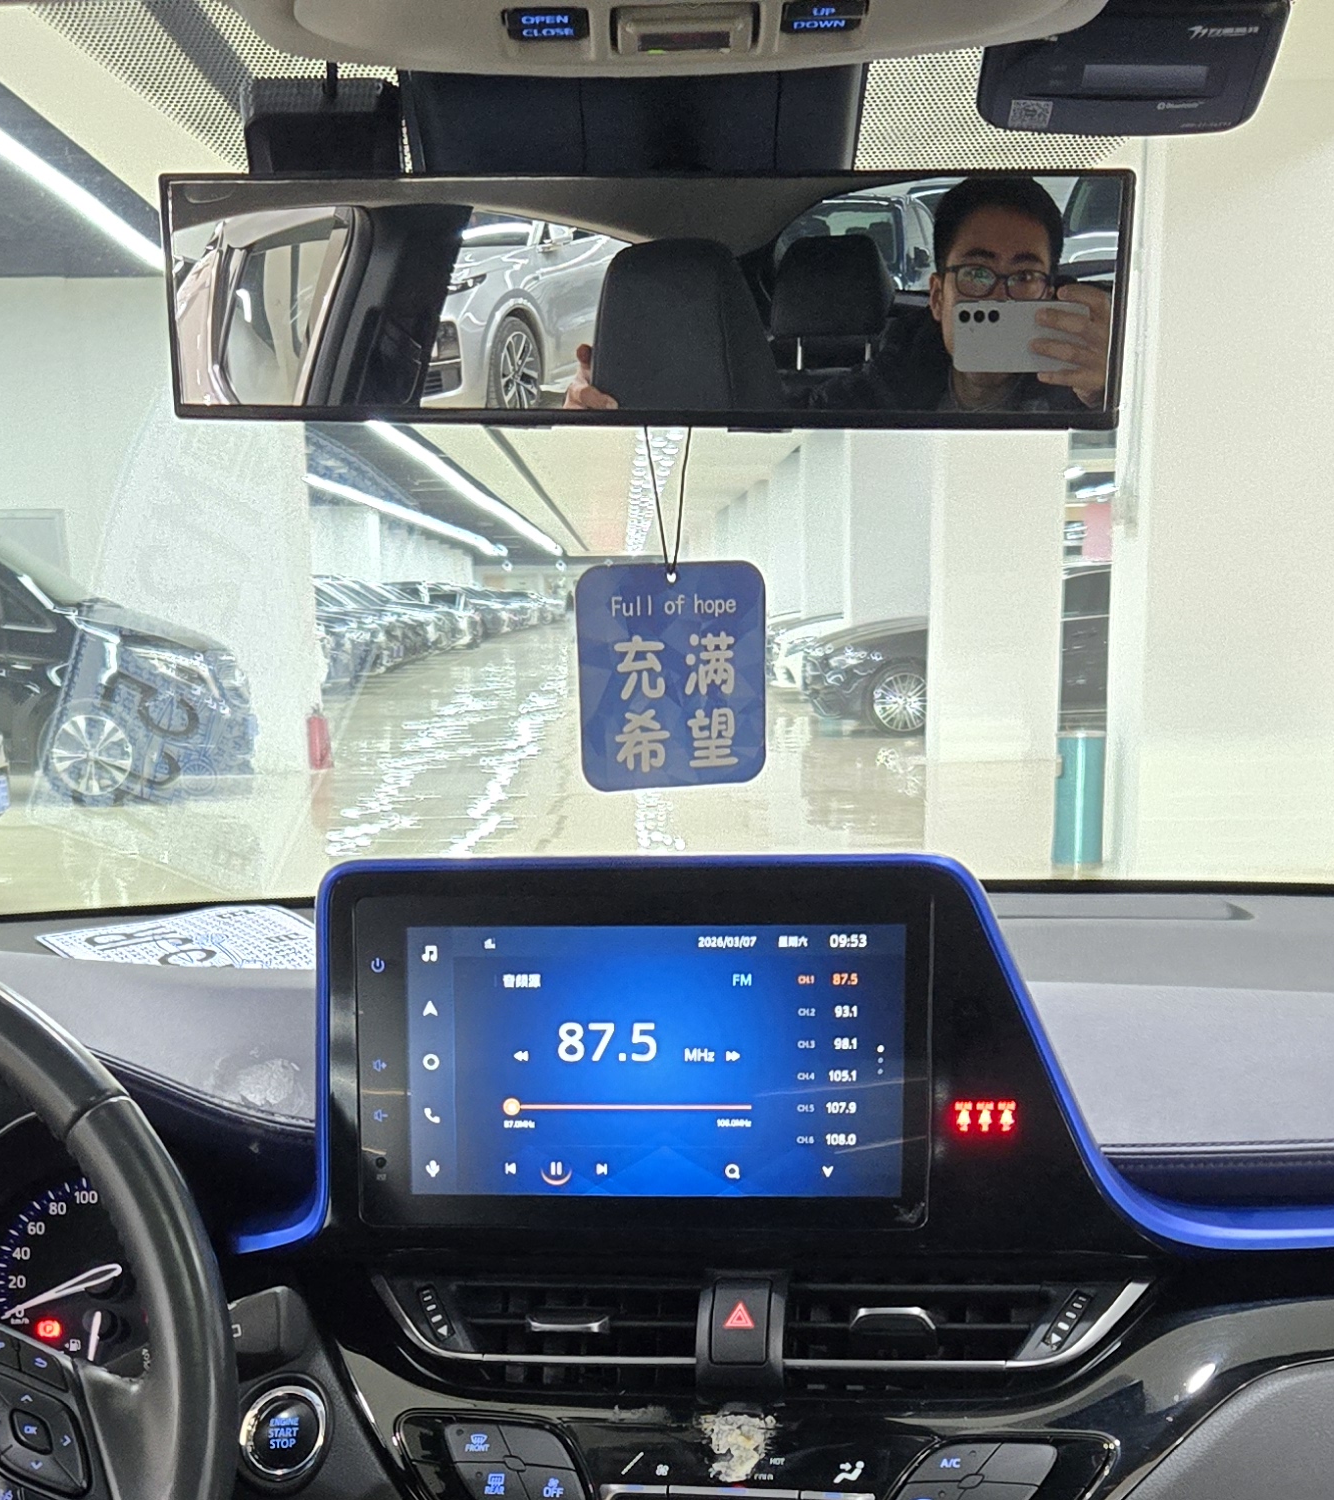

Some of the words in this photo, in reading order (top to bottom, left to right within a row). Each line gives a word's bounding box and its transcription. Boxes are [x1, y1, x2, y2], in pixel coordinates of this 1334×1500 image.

[812, 7, 836, 16] UP
[521, 15, 569, 24] OPEN
[793, 20, 846, 29] DOWN
[522, 28, 574, 37] CLOSE
[611, 595, 652, 617] Full
[664, 595, 685, 615] of
[694, 594, 737, 617] hope
[613, 631, 735, 700] 充满
[614, 708, 739, 773] 希望
[698, 936, 757, 948] 2026/03/07
[829, 934, 867, 948] 09:53
[732, 973, 752, 986] FM
[832, 973, 858, 986] 87.5
[834, 1005, 858, 1018] 93.1
[557, 1022, 658, 1063] 87.5
[684, 1048, 715, 1063] MHz
[833, 1037, 858, 1050] 98.1
[828, 1069, 857, 1082] 105.1
[825, 1101, 857, 1114] 107.9
[825, 1133, 857, 1146] 108.0
[74, 1191, 98, 1204] 100
[48, 1201, 67, 1215] 80
[27, 1221, 46, 1235] 60
[11, 1246, 31, 1260] 40
[8, 1275, 27, 1289] 20
[269, 1417, 300, 1427] ENGINE
[268, 1427, 299, 1438] START
[269, 1438, 296, 1449] STOP
[465, 1443, 490, 1452] FRONT
[939, 1458, 962, 1469] A/C
[484, 1485, 505, 1495] REAR
[543, 1487, 564, 1498] OFF
